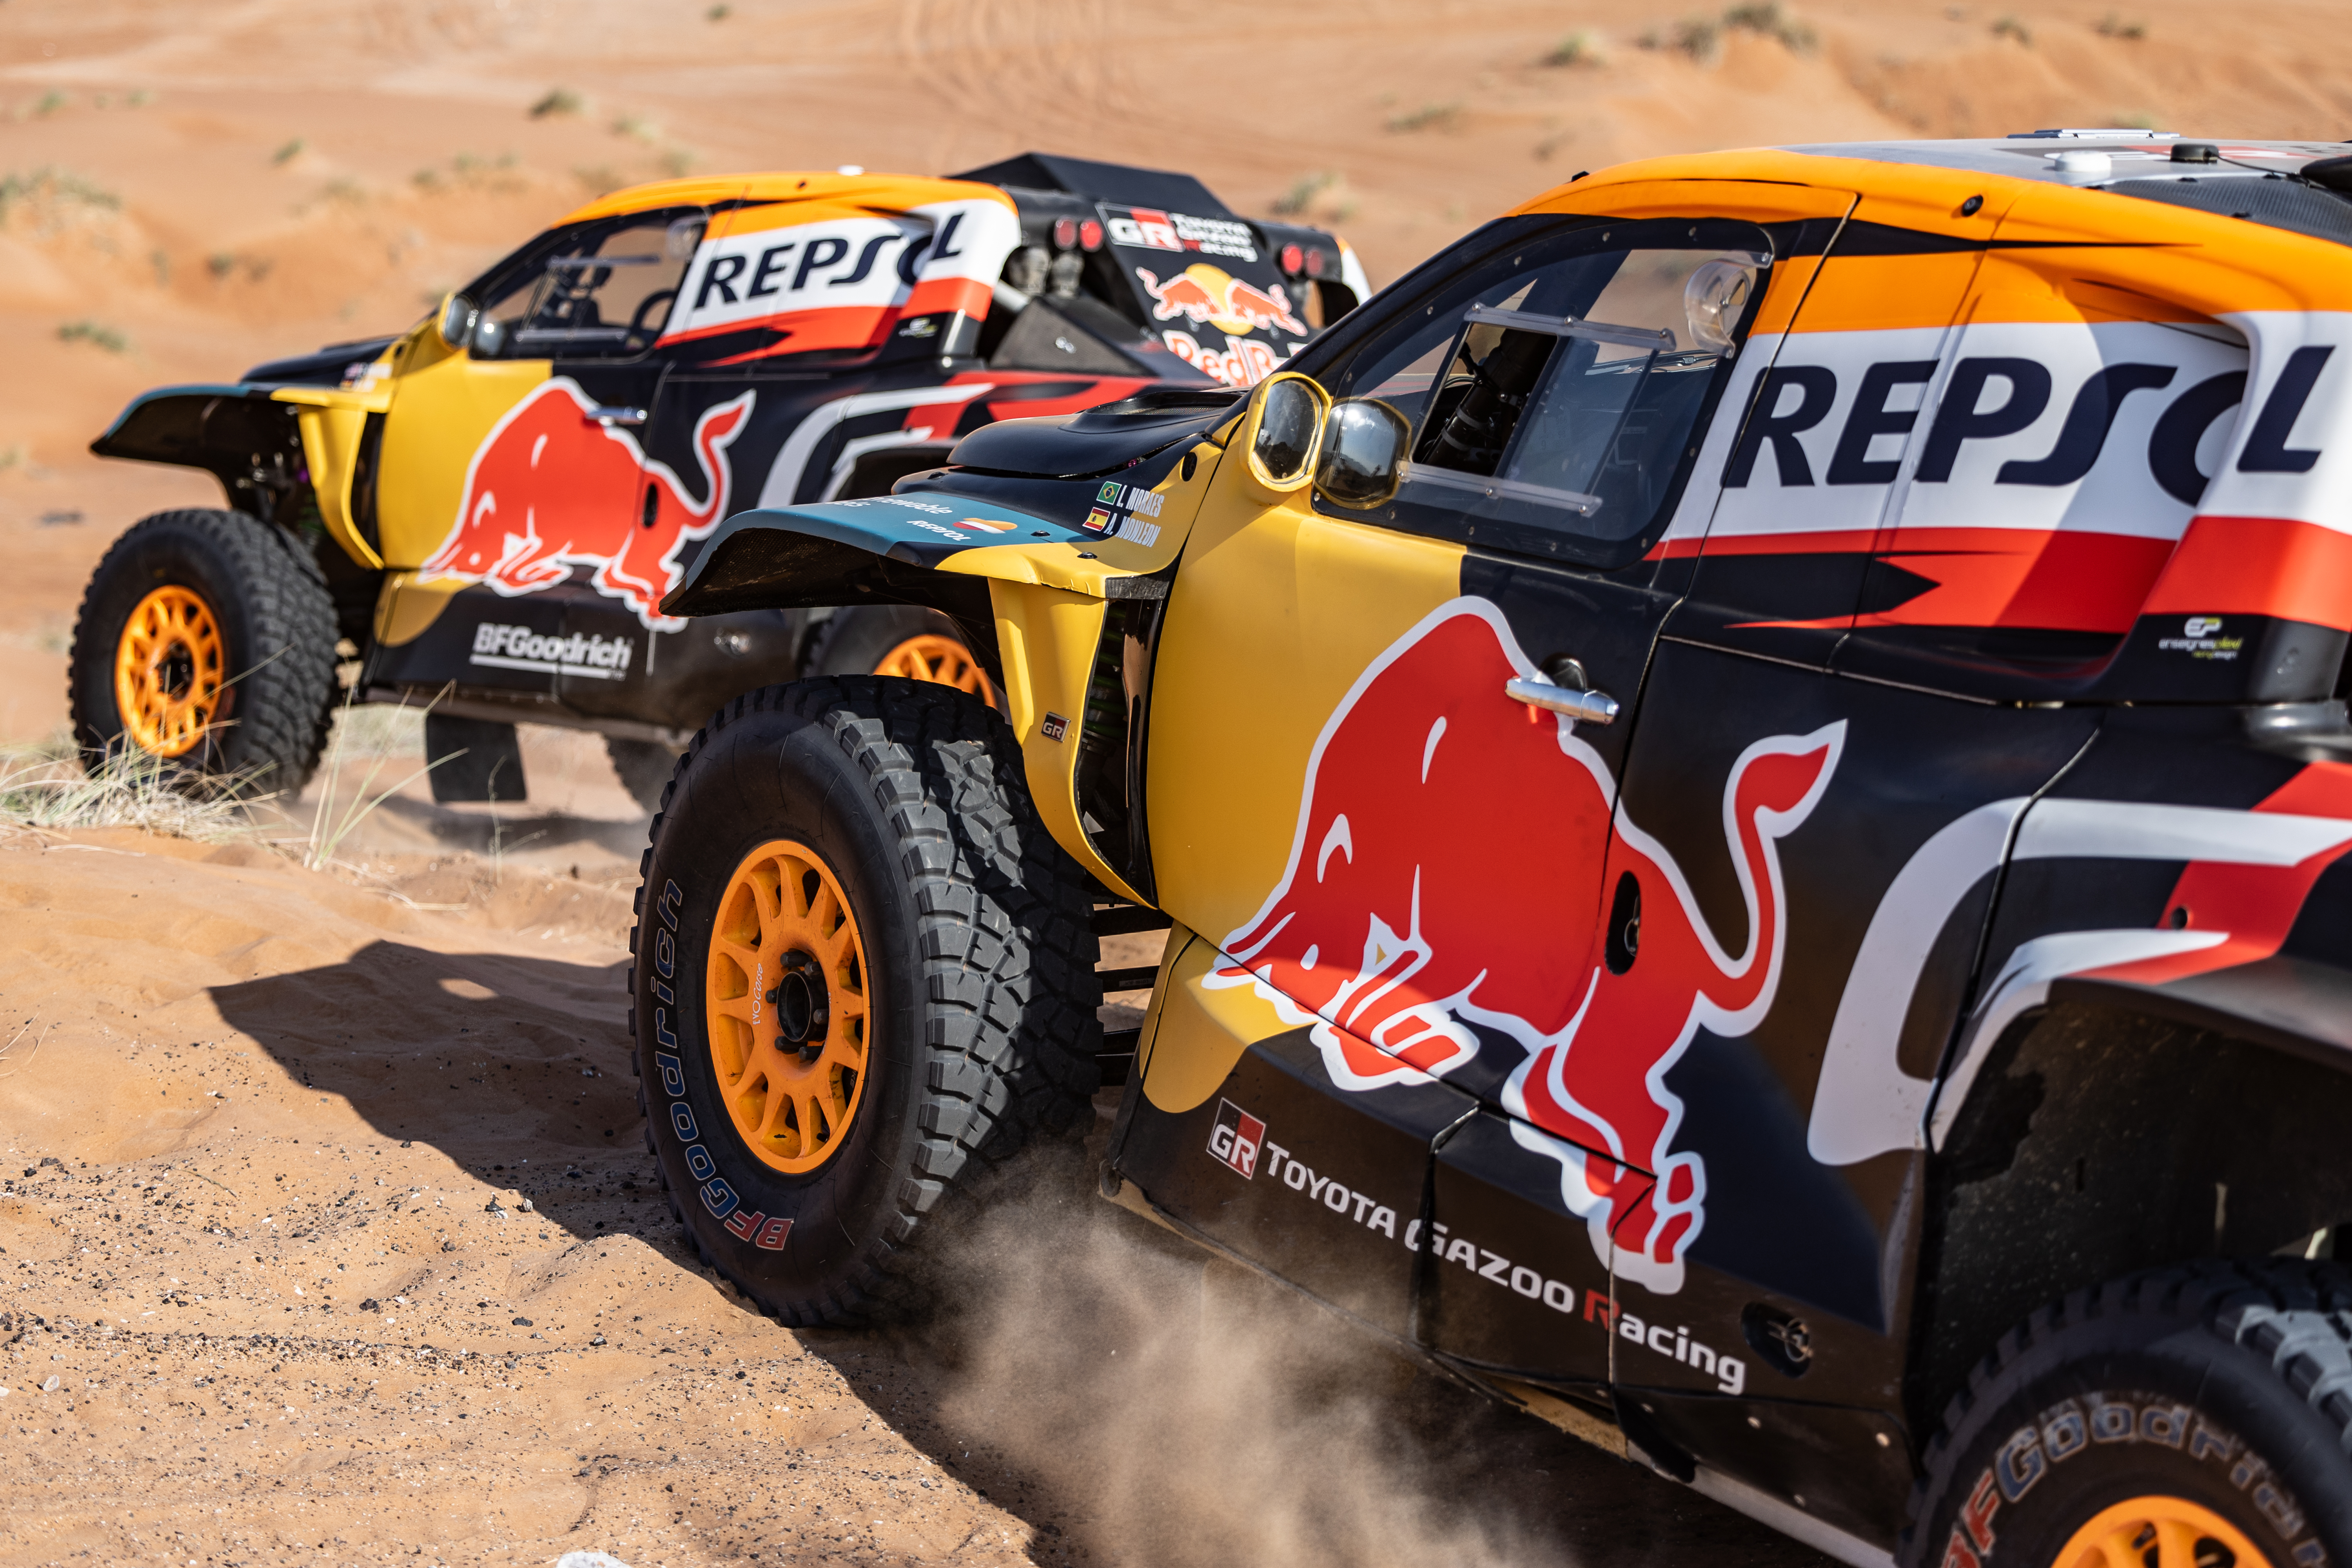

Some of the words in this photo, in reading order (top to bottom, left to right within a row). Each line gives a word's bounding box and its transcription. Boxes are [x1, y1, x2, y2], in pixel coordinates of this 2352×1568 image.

[1108, 218, 1179, 250] GR
[695, 213, 965, 309] REPSOL
[1720, 345, 2336, 508] REPSOL
[1116, 485, 1127, 508] L.
[1125, 487, 1165, 517] MORAES
[906, 520, 971, 541] REPSOL
[1103, 513, 1117, 535] A.
[1114, 516, 1161, 548] MONLEON
[472, 622, 633, 670] BFGoodrich
[1043, 722, 1063, 738] GR
[650, 878, 794, 1251] BFGoodrich
[1211, 1124, 1256, 1174] GR
[1266, 1141, 1396, 1239] TOYOTA
[1405, 1219, 1575, 1313] GAZOO
[1583, 1289, 1746, 1396] Racing
